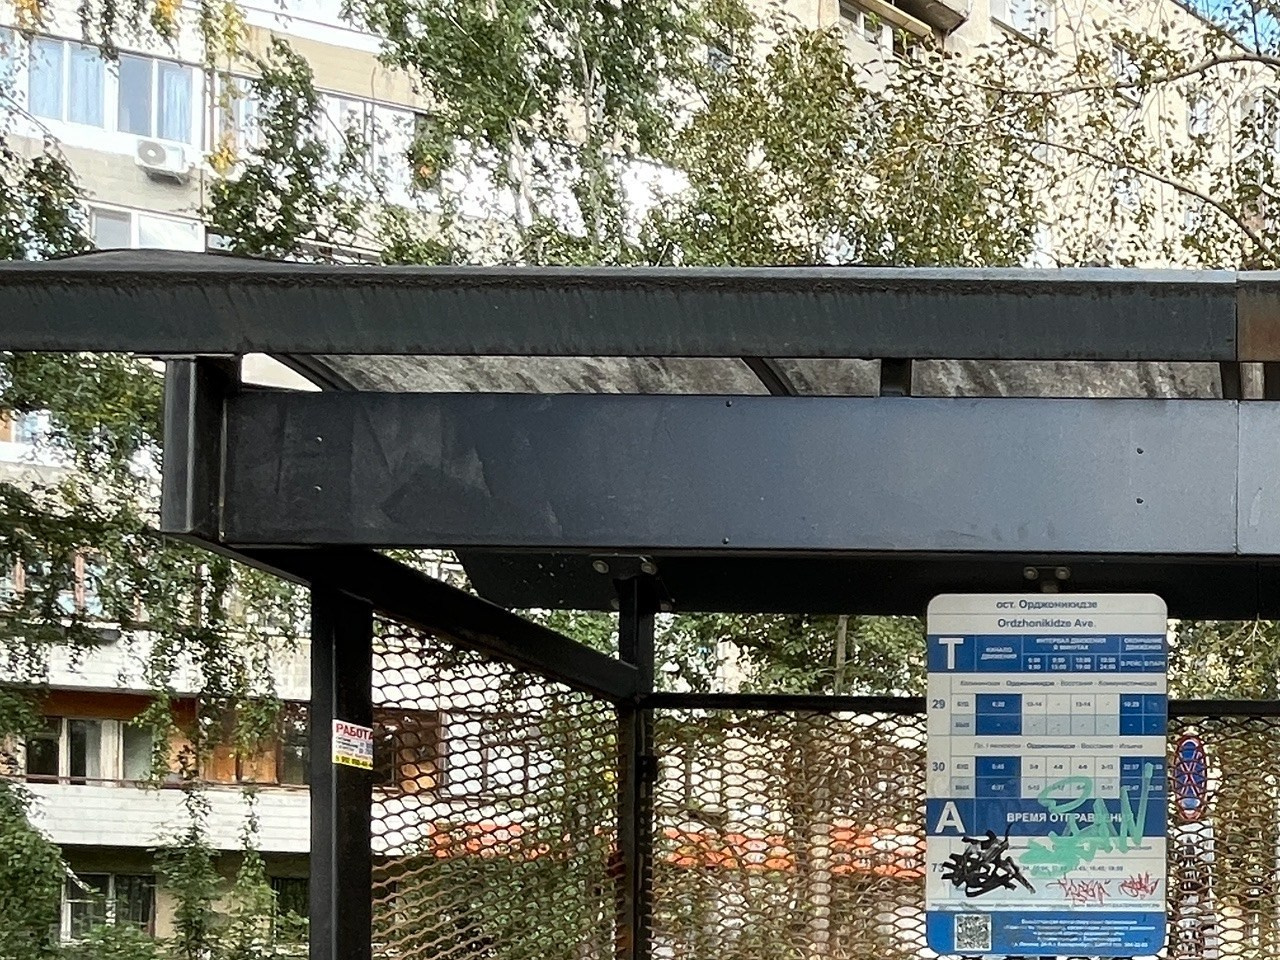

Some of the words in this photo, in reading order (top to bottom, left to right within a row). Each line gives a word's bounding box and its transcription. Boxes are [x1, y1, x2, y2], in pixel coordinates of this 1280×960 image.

[996, 601, 1016, 609] ост.
[1018, 599, 1098, 611] Орджоникидзе
[997, 618, 1072, 628] Ordzhonikidze
[1074, 618, 1097, 628] Ave.
[938, 637, 964, 670] Т
[931, 699, 946, 710] 29
[335, 723, 374, 740] РАБОТА
[932, 761, 946, 772] 30
[934, 801, 966, 834] А
[1006, 812, 1047, 823] ВРЕМЯ
